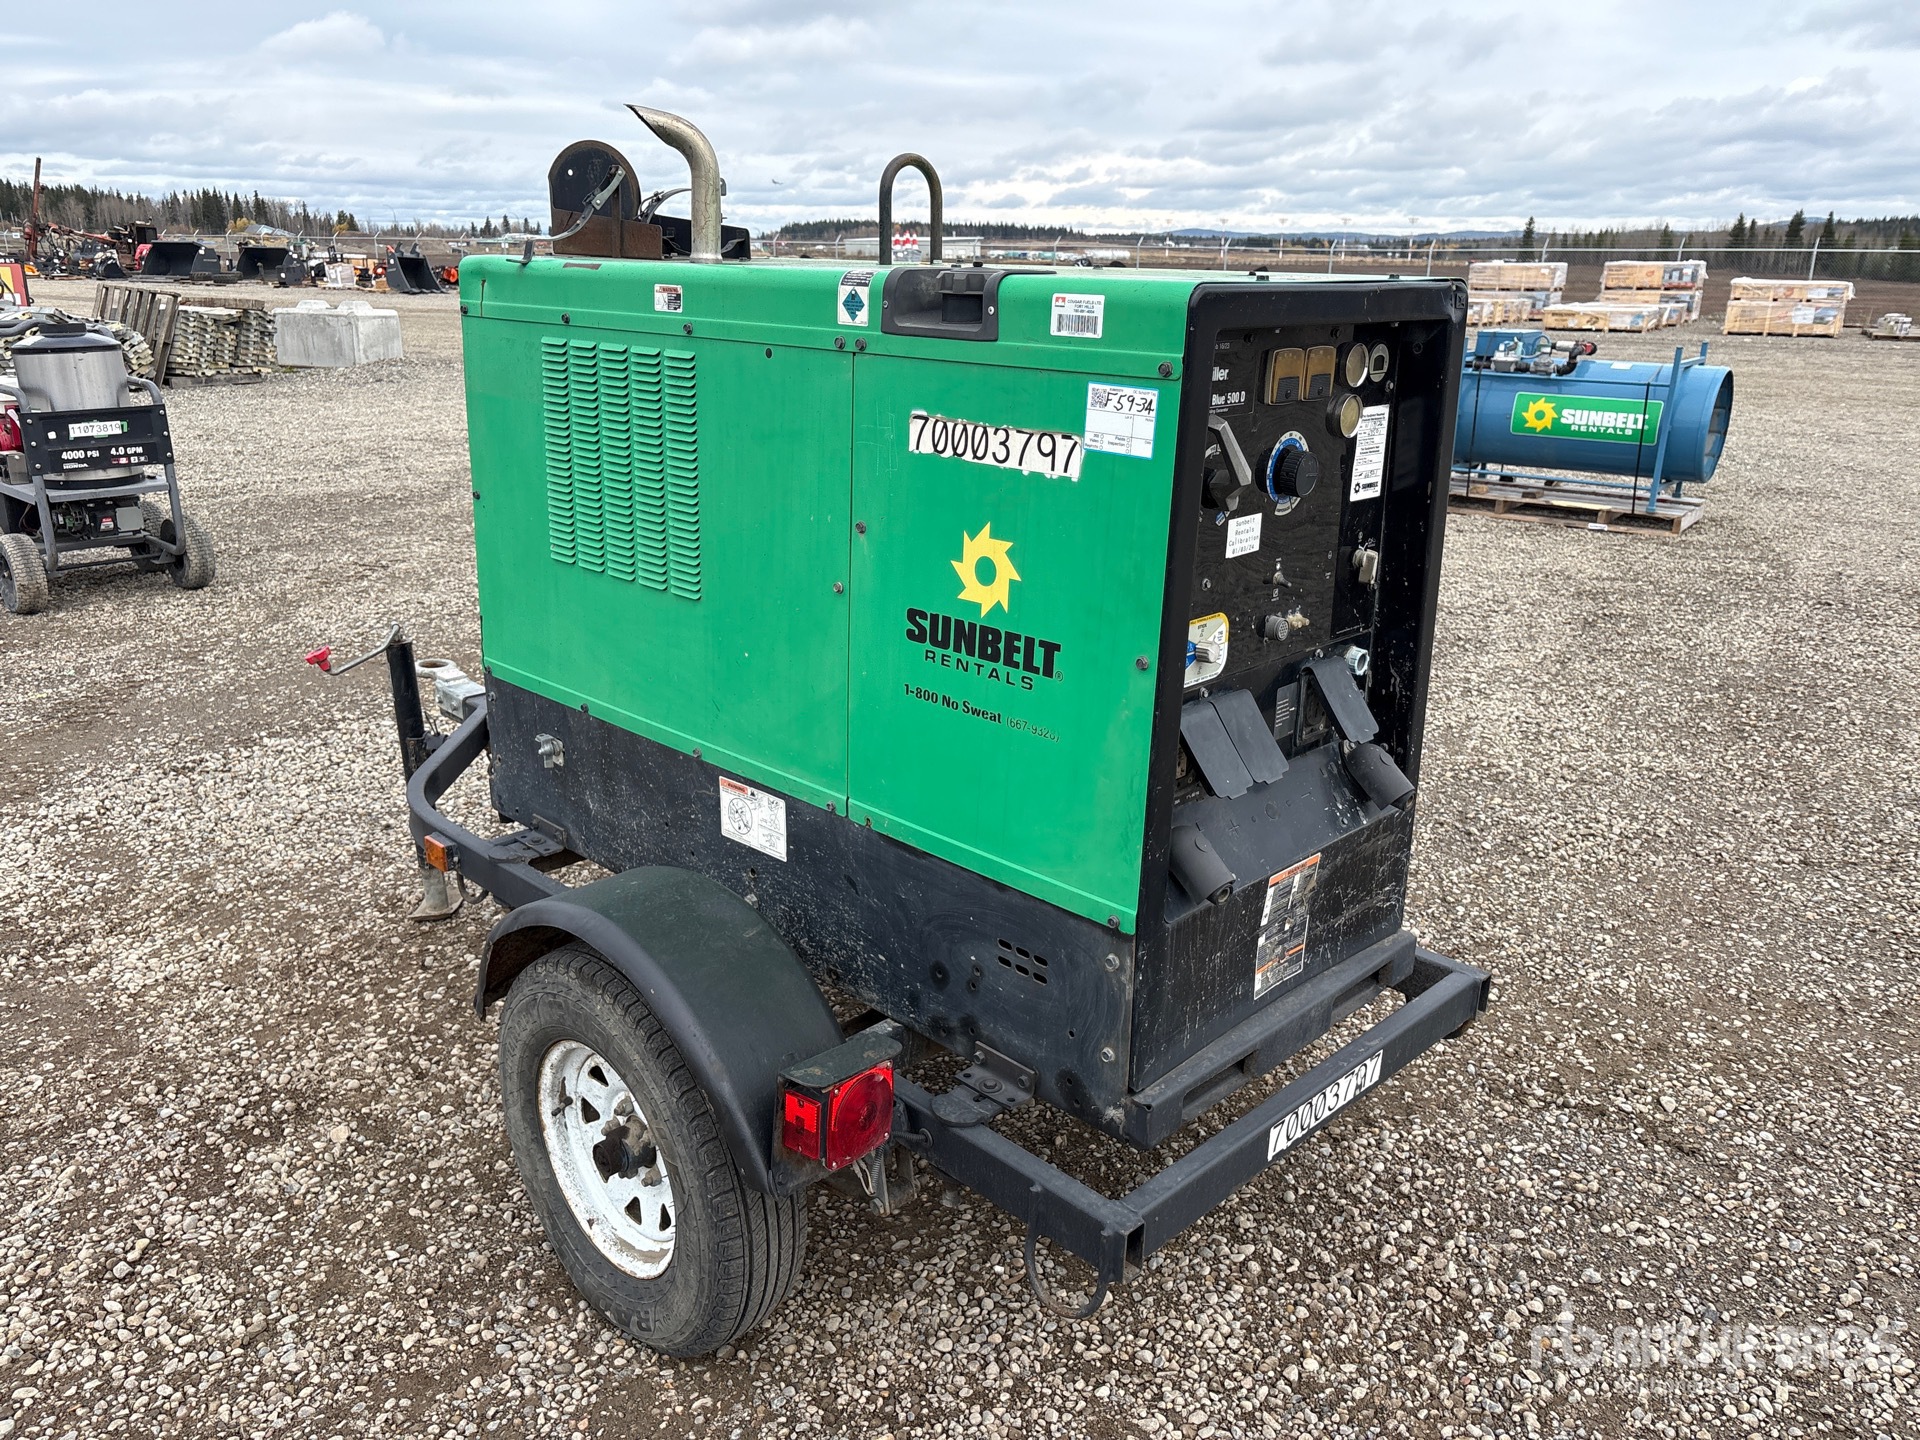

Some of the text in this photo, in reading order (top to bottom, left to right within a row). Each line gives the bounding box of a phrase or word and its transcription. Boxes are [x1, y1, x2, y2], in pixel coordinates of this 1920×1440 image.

[1212, 366, 1229, 381] iller
[1212, 393, 1226, 405] Blue
[1227, 391, 1240, 404] 500
[1560, 408, 1649, 429] SUNBELT
[71, 422, 121, 435] 11073819
[1571, 425, 1633, 435] RENTALS
[911, 415, 1082, 474] 70003797
[61, 446, 143, 460] 4000 PSI 4.0 GPM
[1236, 517, 1256, 527] Sunbelt
[1234, 527, 1255, 536] Rentals
[1228, 535, 1259, 547] Calibration
[906, 608, 1062, 679] SUNBELT
[924, 649, 1034, 691] RENTALS
[904, 683, 938, 704] 1-800
[941, 694, 959, 711] No
[962, 700, 1002, 724] Sweat
